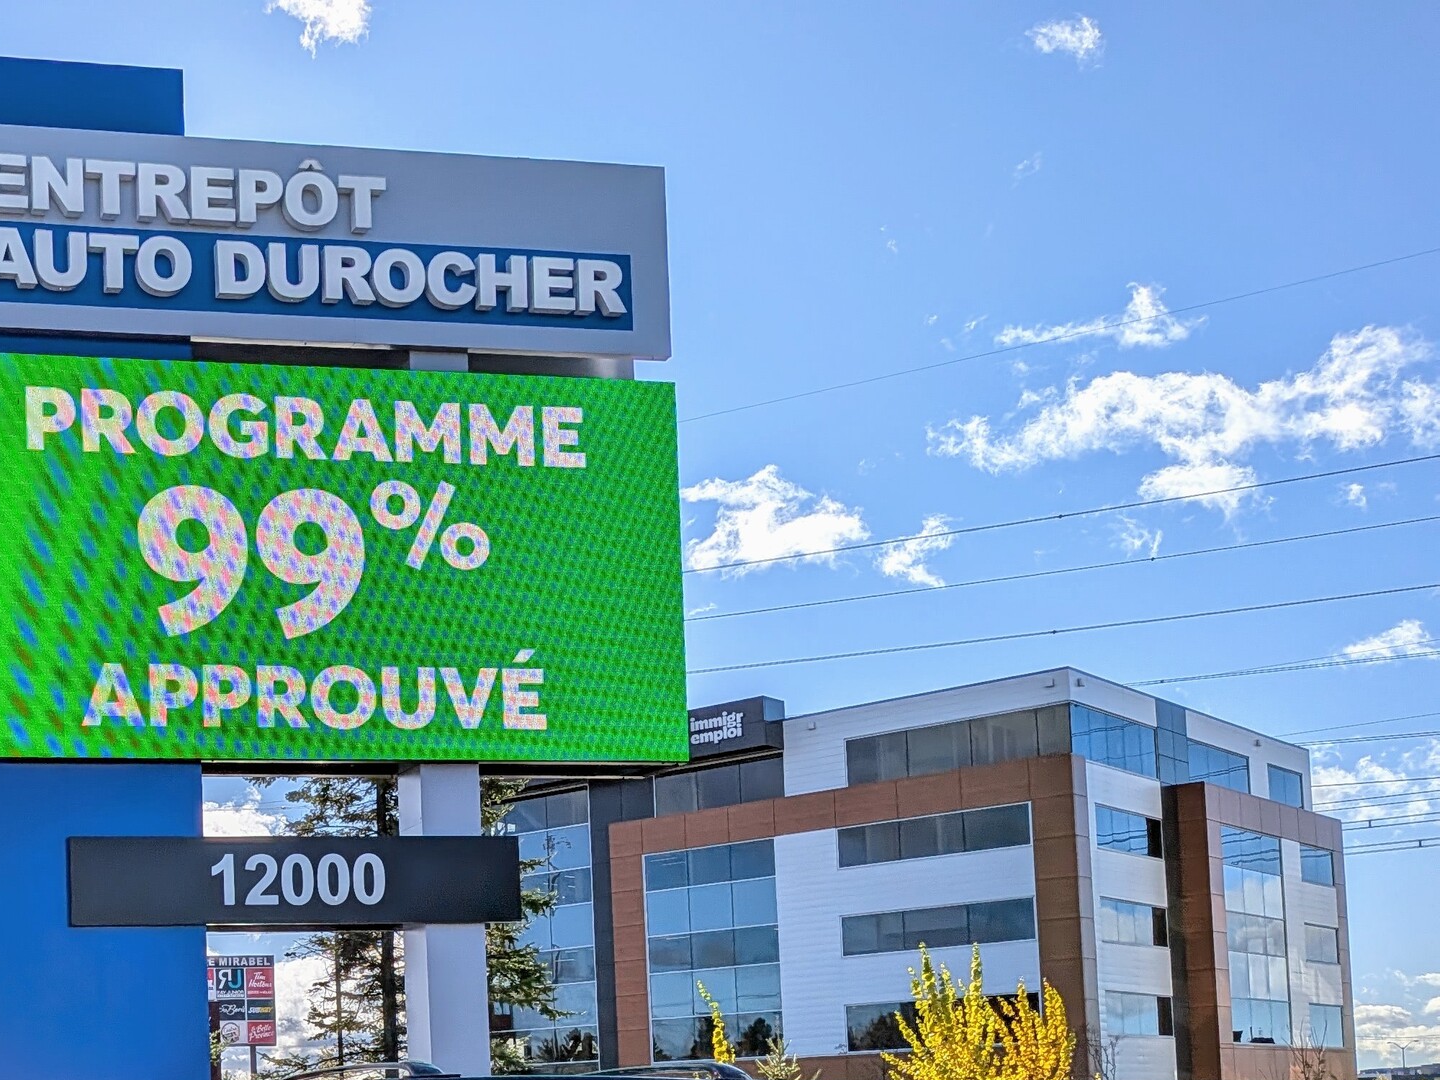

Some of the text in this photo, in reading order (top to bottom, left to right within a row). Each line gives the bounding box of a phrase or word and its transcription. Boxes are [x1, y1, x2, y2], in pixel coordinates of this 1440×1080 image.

[215, 240, 628, 318] DUROCHER
[25, 385, 587, 469] PROGRAMME
[137, 479, 491, 640] 99%
[81, 648, 548, 731] APPROUVÉ
[689, 711, 744, 732] immigr
[690, 723, 743, 745] emploi
[211, 853, 387, 906] 12000
[219, 957, 271, 967] MIRABEL
